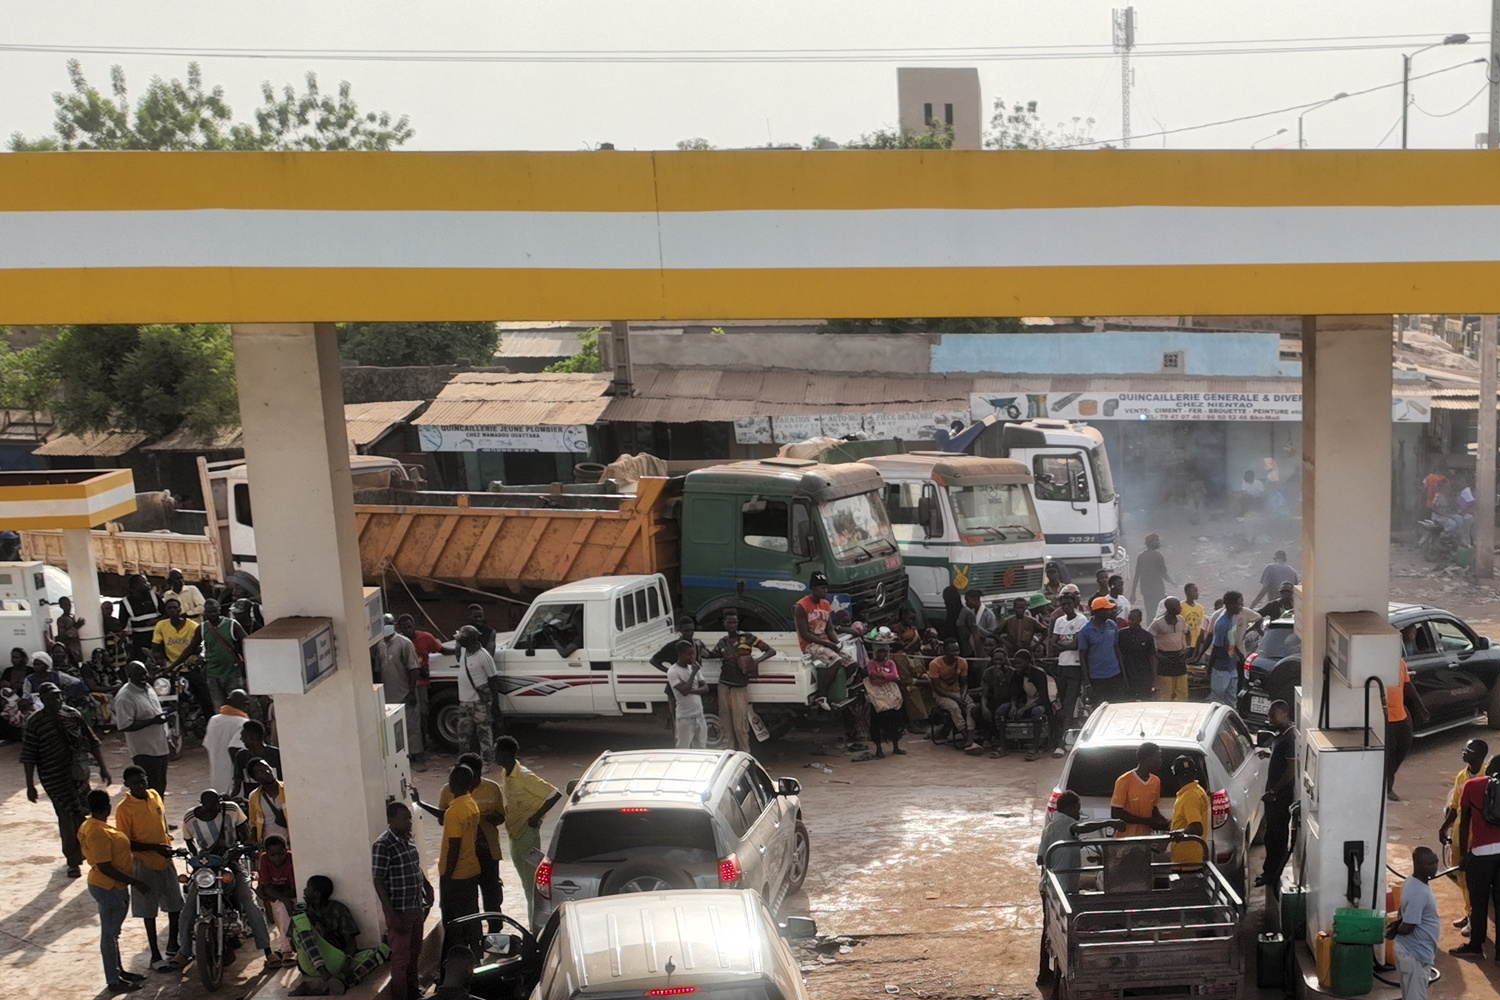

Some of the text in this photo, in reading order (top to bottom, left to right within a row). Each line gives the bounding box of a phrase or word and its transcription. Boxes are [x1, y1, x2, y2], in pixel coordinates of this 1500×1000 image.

[1119, 393, 1200, 402] QUINCAILLERIE
[1203, 393, 1260, 402] GENERALE
[1262, 394, 1270, 402] &
[441, 425, 563, 433] QUINCAILLERIE JEUNE PLOMBIER
